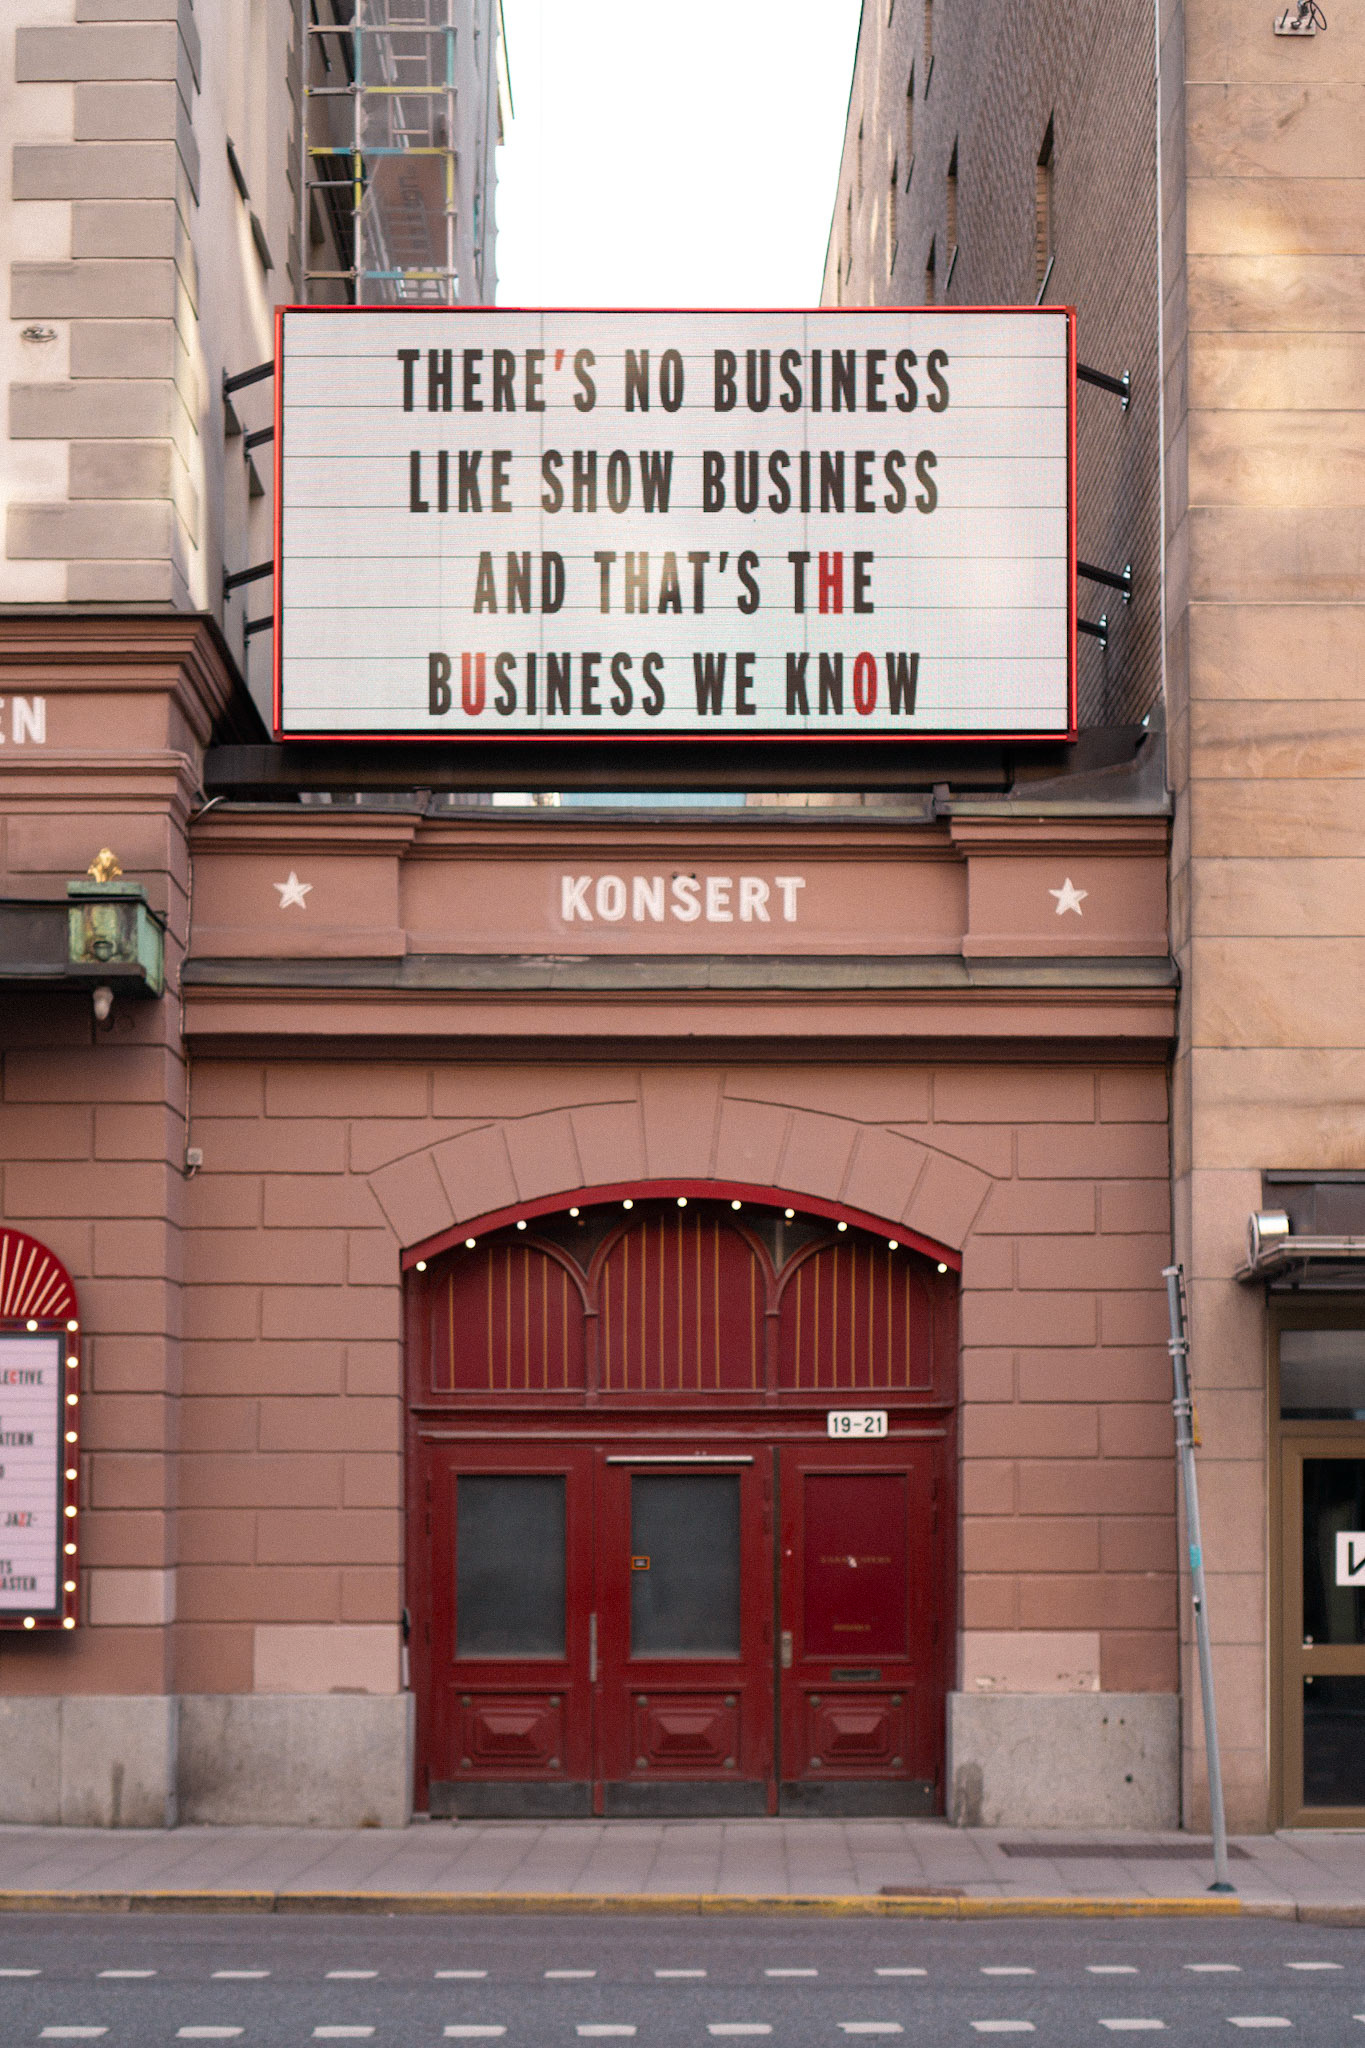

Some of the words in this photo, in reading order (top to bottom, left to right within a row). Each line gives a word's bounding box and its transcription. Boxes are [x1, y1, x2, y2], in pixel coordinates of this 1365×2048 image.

[398, 349, 597, 412] THERE'S
[625, 349, 685, 412] NO
[714, 349, 950, 412] BUSINESS
[410, 450, 512, 513] LIKE
[541, 450, 673, 513] SHOW
[703, 450, 938, 514] BUSINESS
[474, 551, 565, 614] AND
[594, 550, 760, 614] THAT'S
[788, 551, 874, 614] THE
[428, 652, 665, 716] BUSINESS
[693, 652, 756, 716] WE
[786, 652, 920, 716] KNOW
[0, 696, 46, 744] N
[561, 875, 806, 922] KONSERT
[833, 1416, 882, 1433] 19-21
